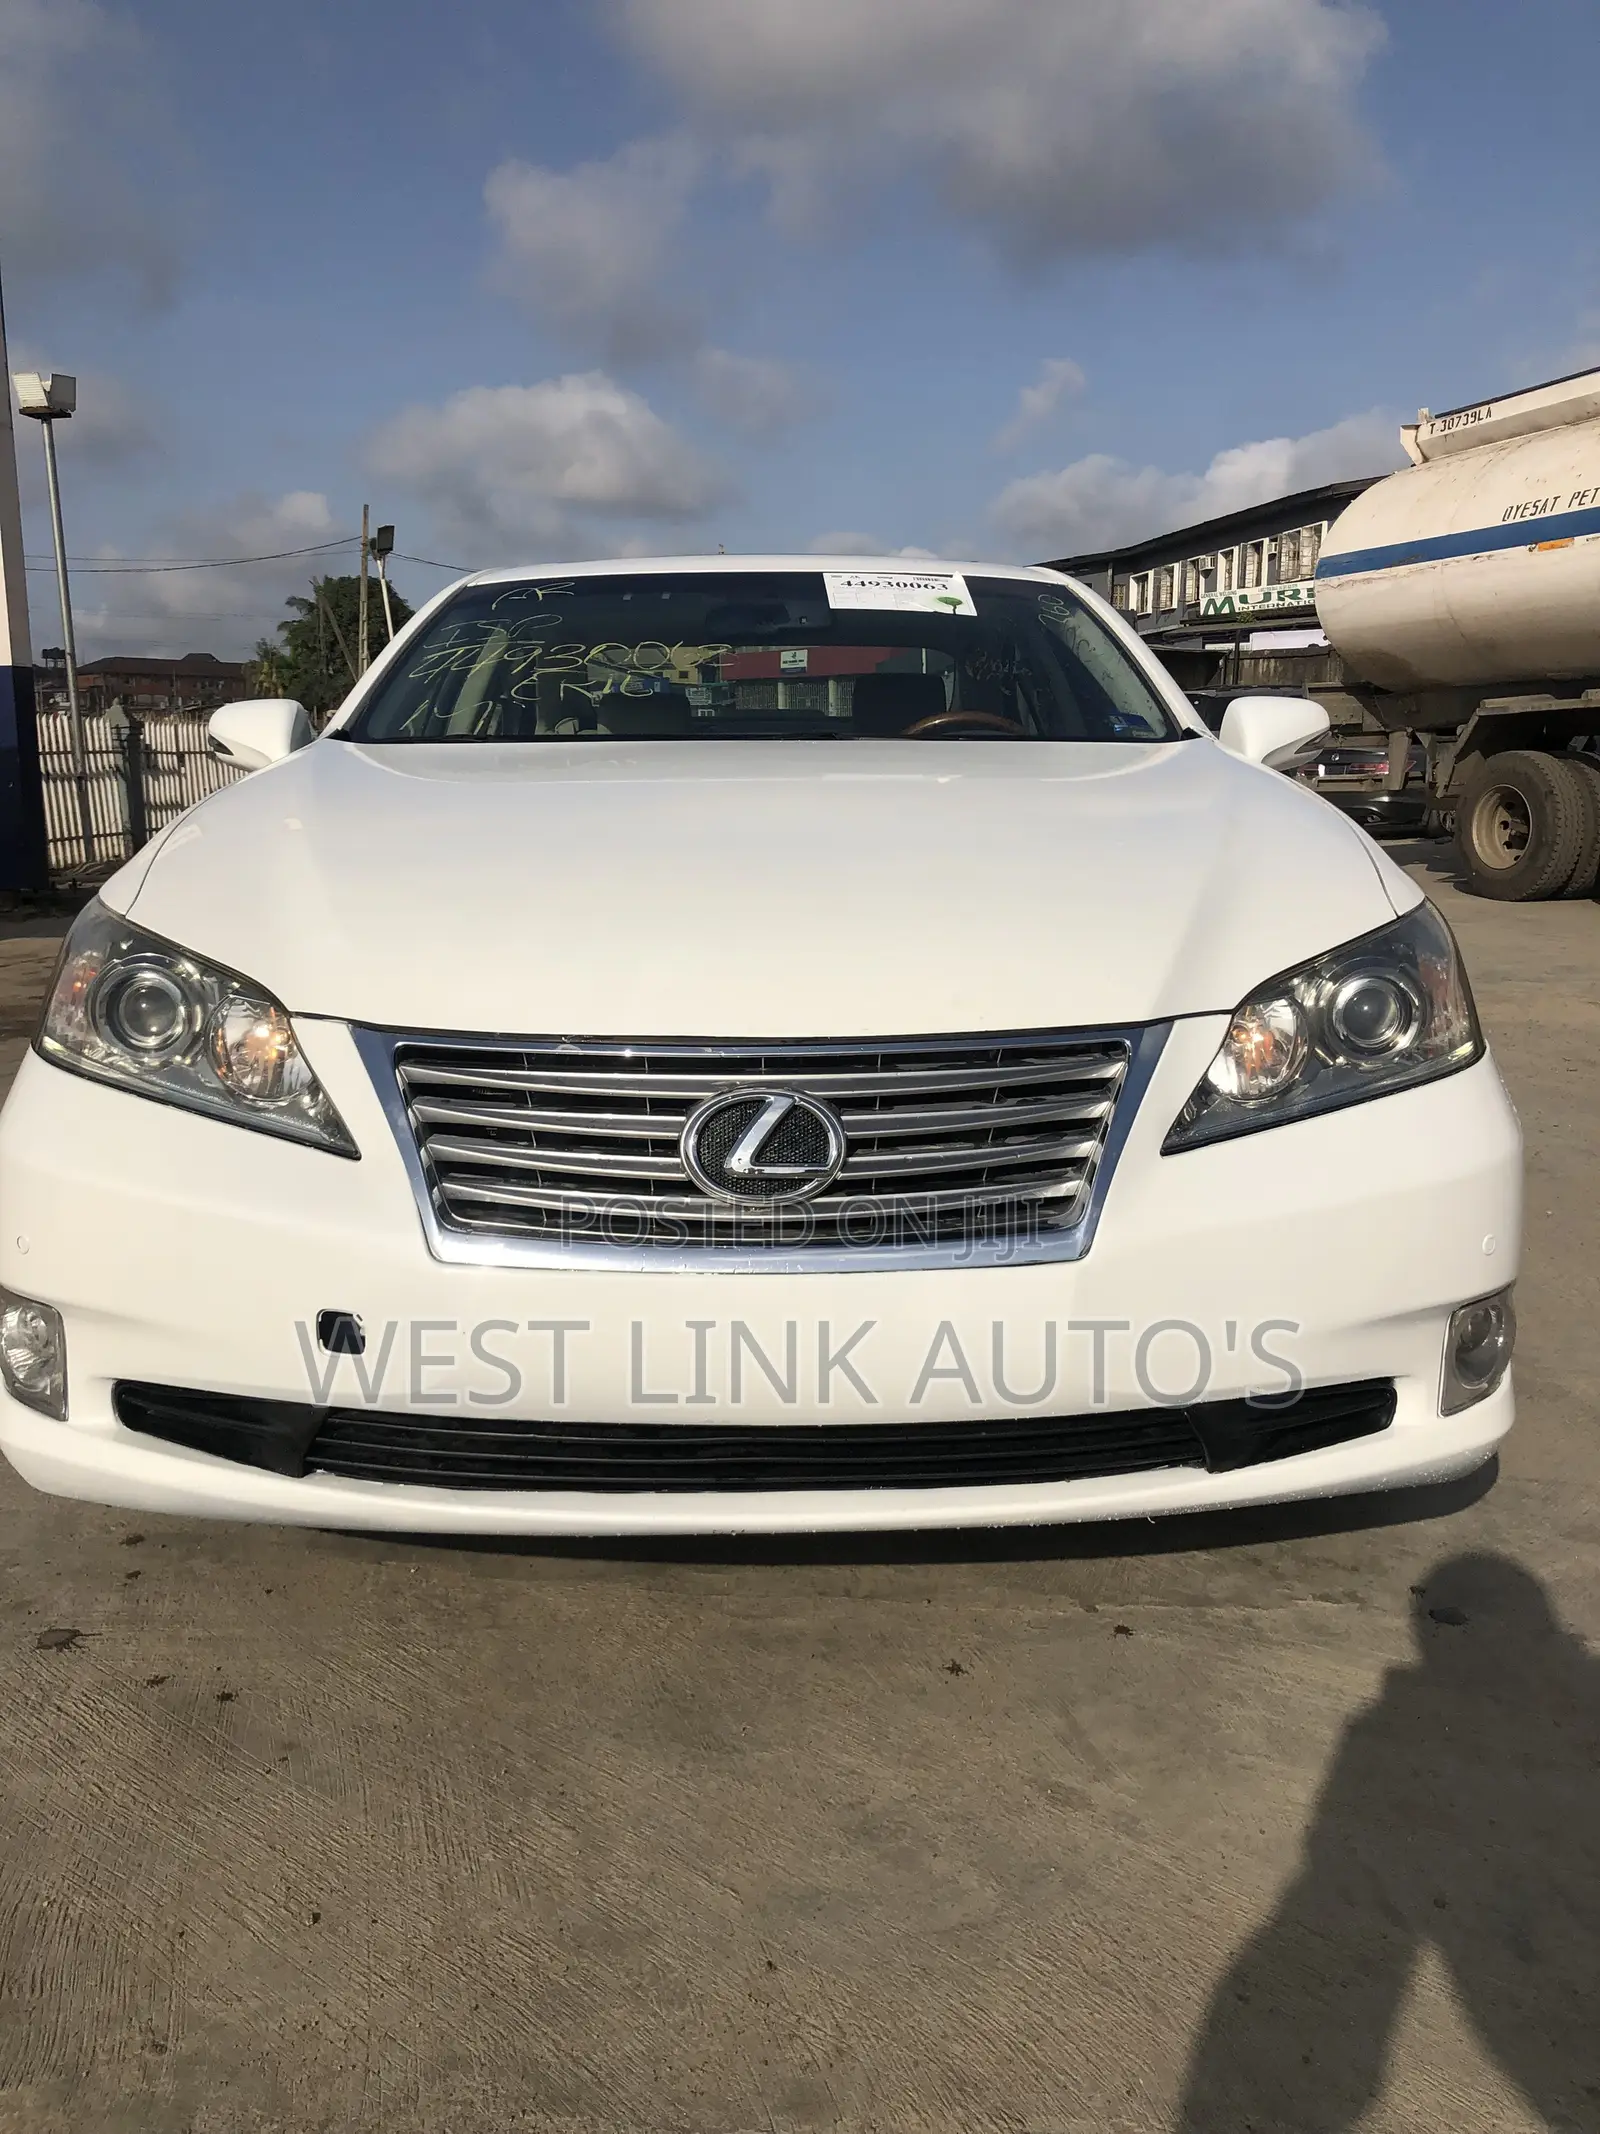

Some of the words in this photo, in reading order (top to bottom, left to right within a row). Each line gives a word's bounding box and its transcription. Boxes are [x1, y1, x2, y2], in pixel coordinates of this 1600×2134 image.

[1502, 495, 1561, 522] OYESAT
[1567, 486, 1600, 508] PET
[840, 579, 949, 591] 44930063
